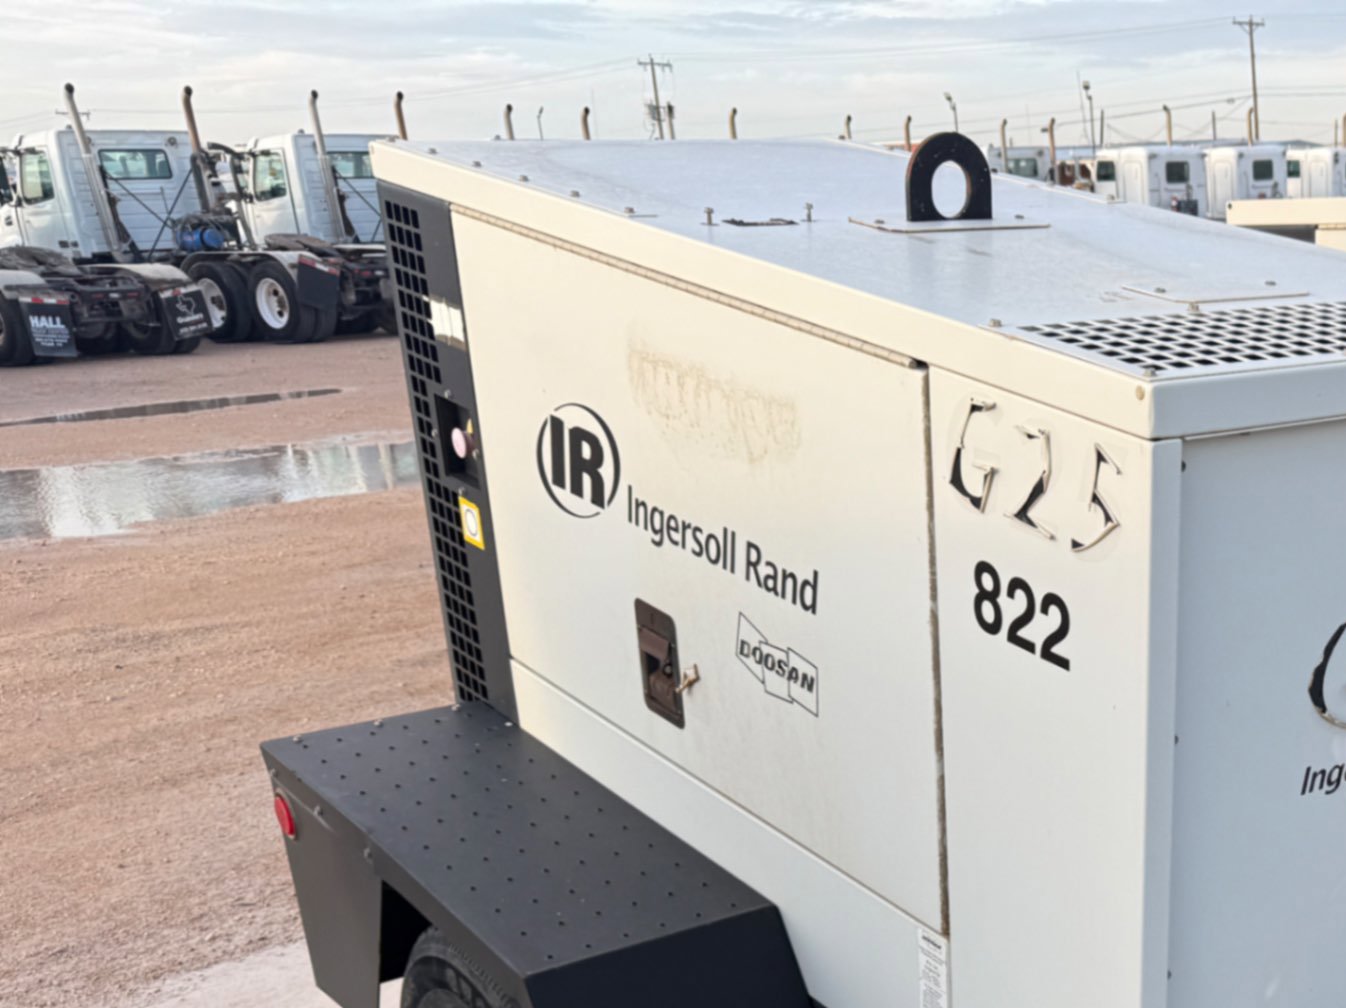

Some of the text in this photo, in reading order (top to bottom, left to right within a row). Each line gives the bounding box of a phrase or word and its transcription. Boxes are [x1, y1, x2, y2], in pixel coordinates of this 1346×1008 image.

[29, 315, 66, 328] HALL
[549, 414, 606, 510] IR
[627, 484, 819, 615] Ingersoll Rand
[974, 560, 1071, 672] 822
[739, 638, 815, 693] DOOSAN
